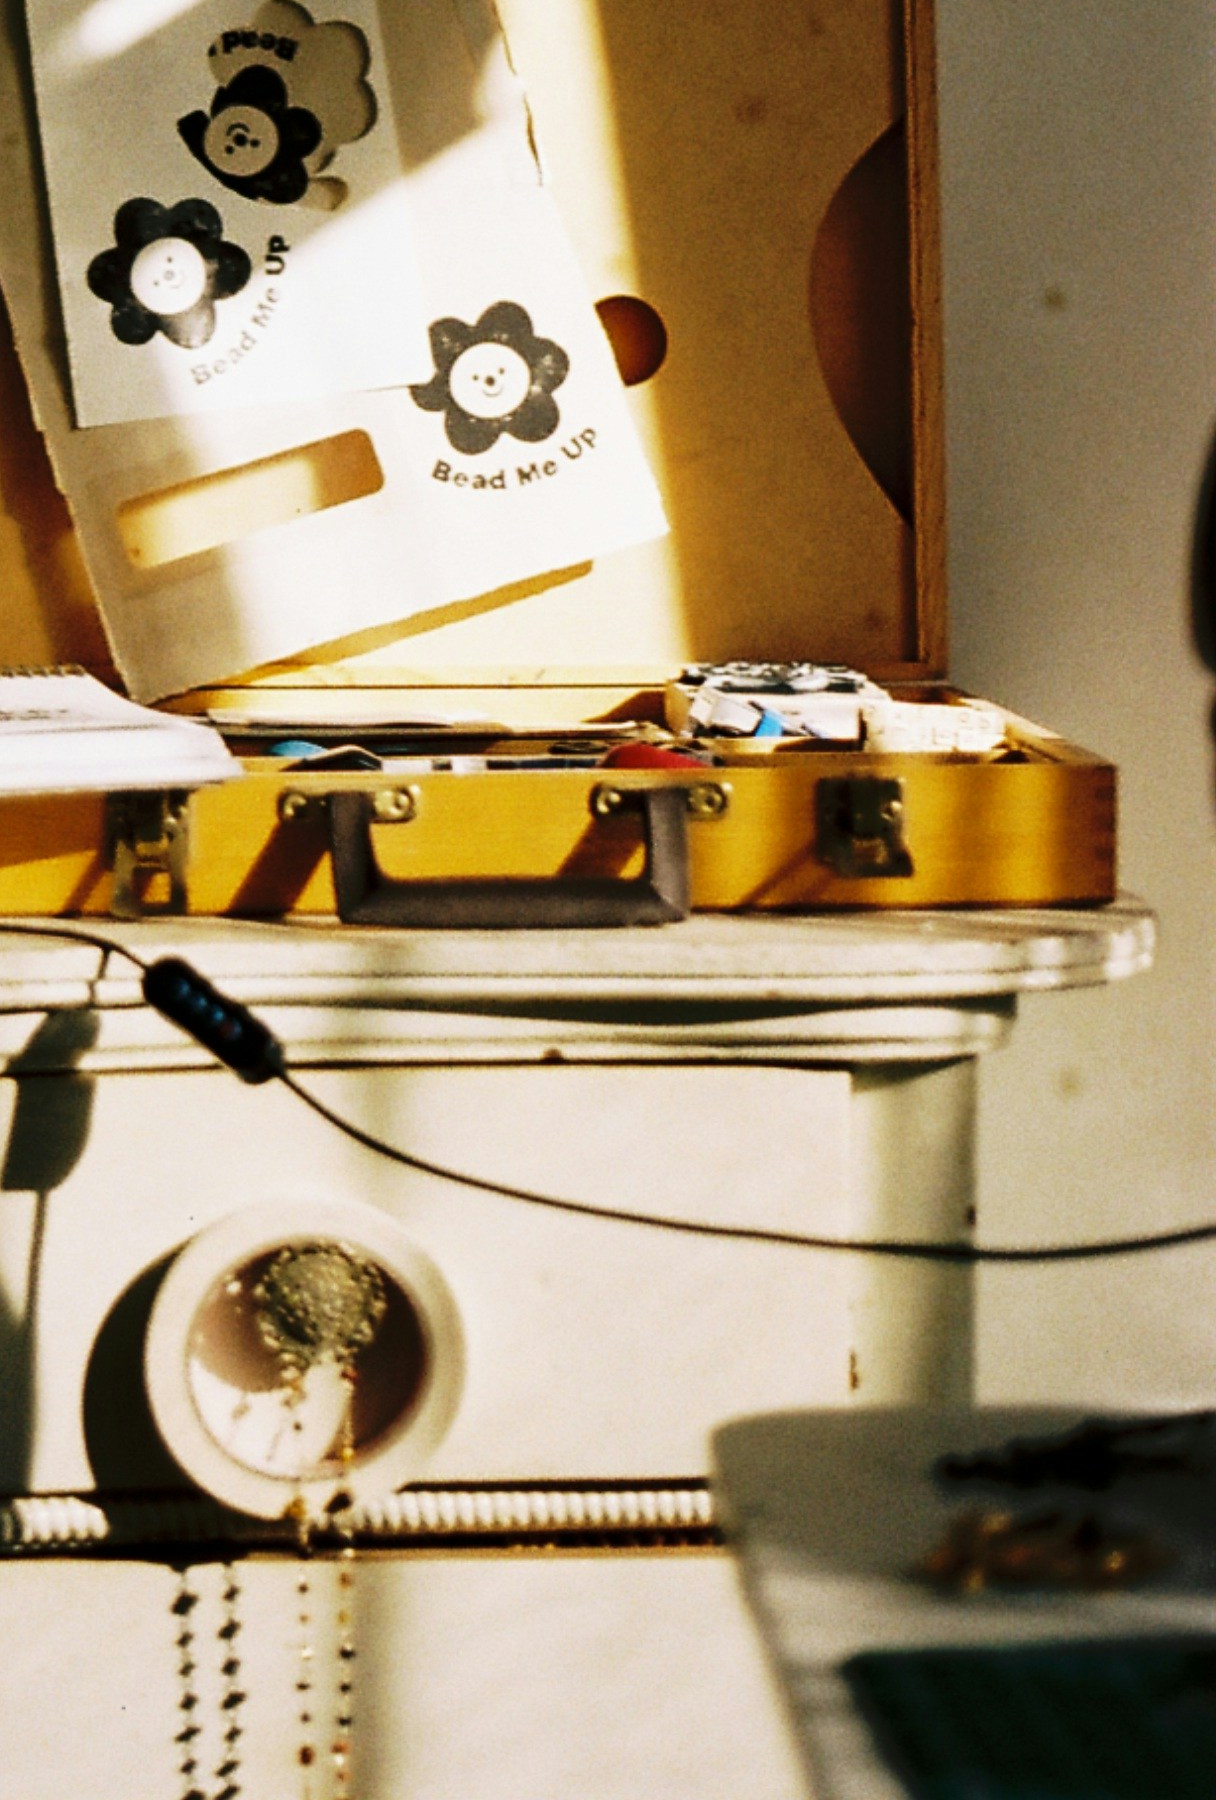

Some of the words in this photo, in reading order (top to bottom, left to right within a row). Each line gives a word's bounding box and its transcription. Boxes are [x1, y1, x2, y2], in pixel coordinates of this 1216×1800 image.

[220, 28, 299, 62] Bead
[189, 327, 259, 387] Bead
[249, 285, 282, 330] Me
[431, 459, 507, 490] Bead
[515, 459, 558, 486] Me
